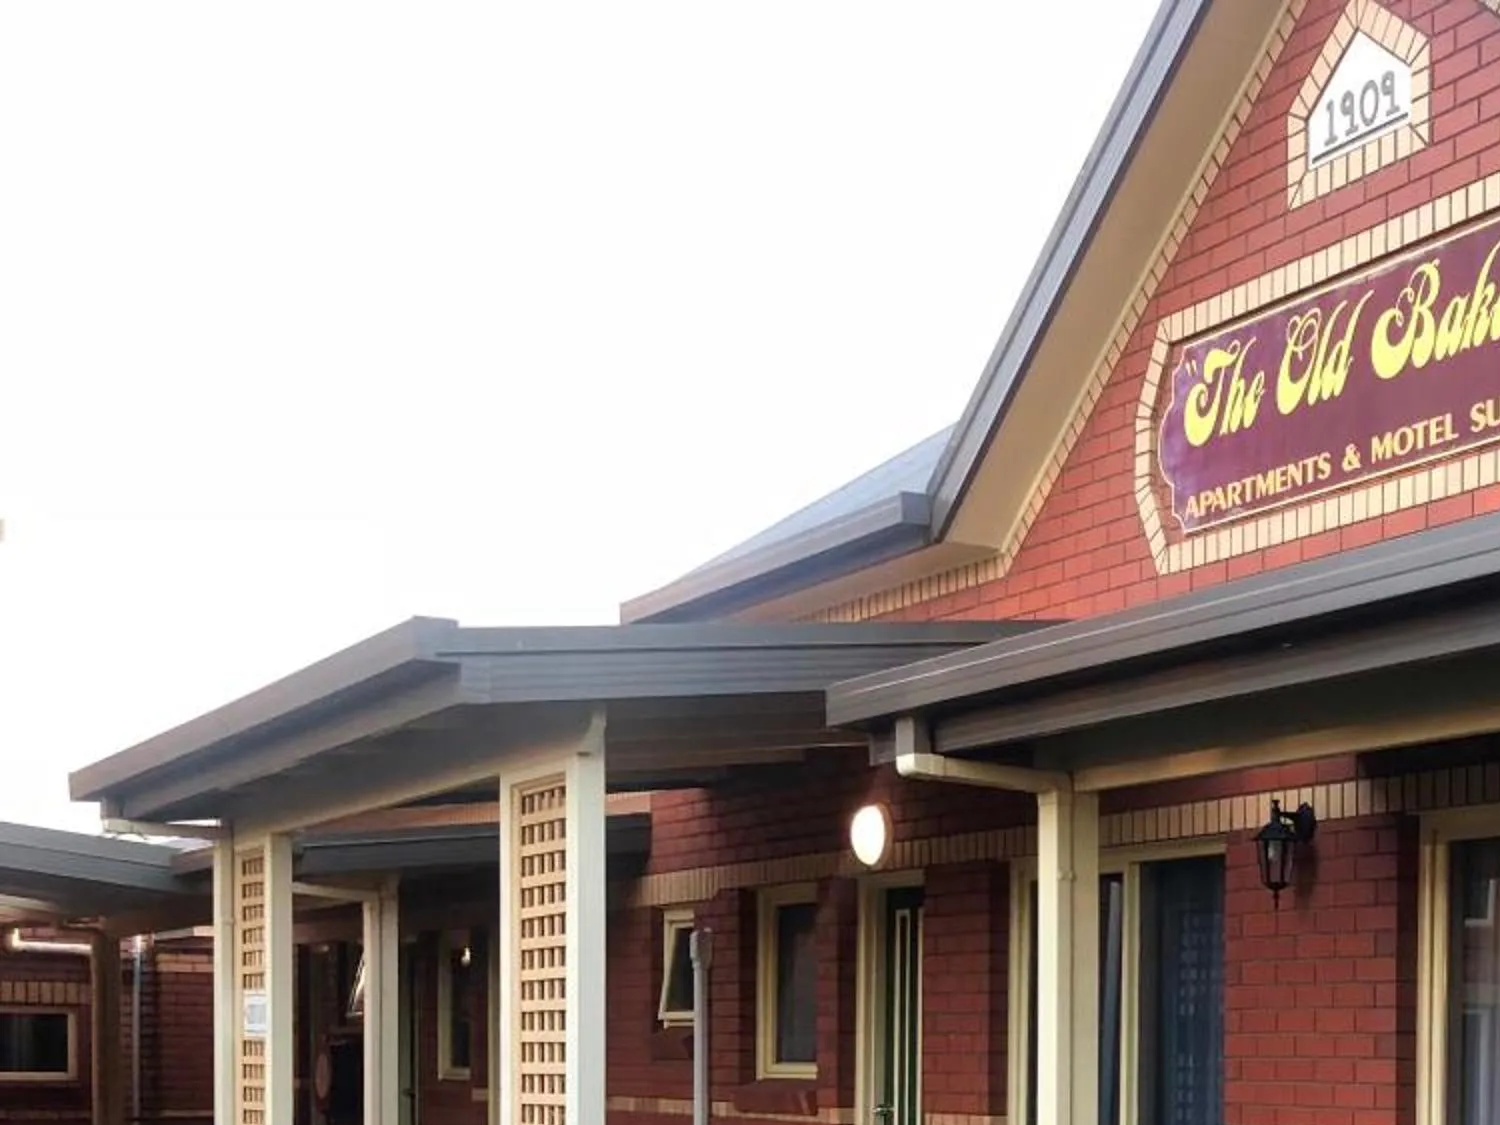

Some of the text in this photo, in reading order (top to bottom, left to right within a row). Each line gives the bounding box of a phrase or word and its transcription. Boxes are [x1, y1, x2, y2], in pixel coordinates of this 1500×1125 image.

[1324, 70, 1400, 146] 1909
[1277, 290, 1375, 416] Old
[1184, 455, 1331, 520] APARTMENTS
[1342, 446, 1361, 472] &
[1371, 412, 1458, 461] MOTEL
